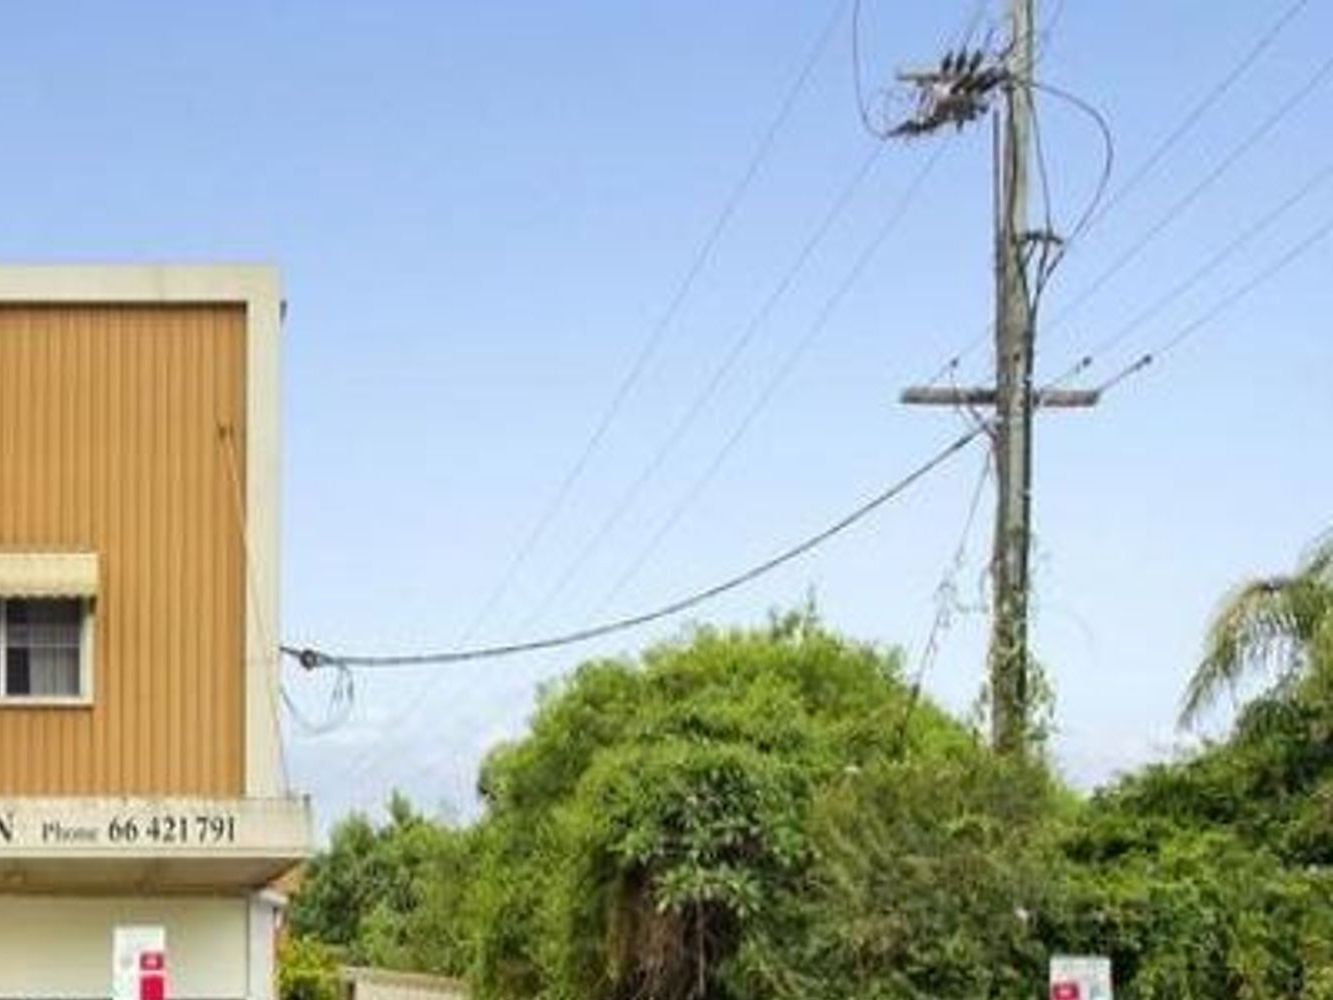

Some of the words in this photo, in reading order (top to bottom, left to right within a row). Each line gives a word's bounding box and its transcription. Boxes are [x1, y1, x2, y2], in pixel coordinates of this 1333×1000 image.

[108, 817, 138, 843] 66
[145, 816, 189, 843] 421
[196, 816, 236, 843] 791
